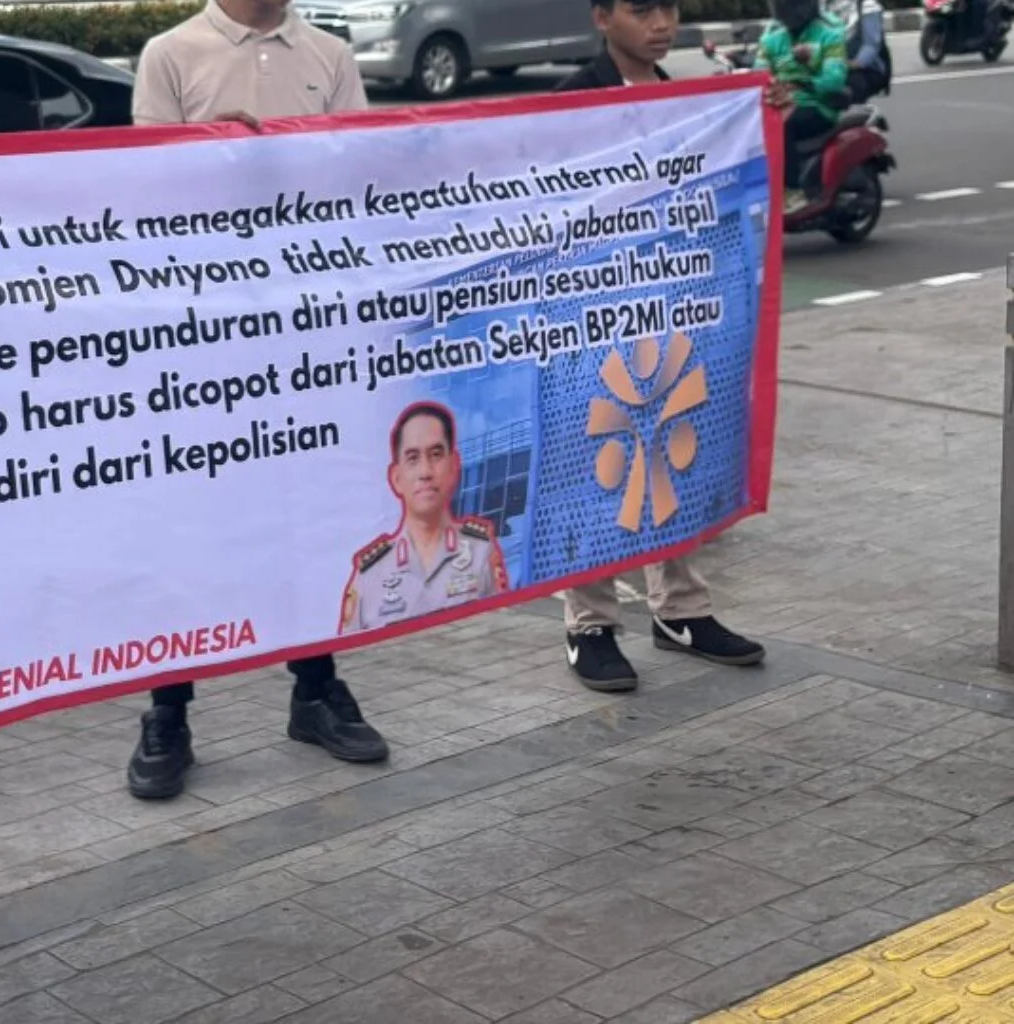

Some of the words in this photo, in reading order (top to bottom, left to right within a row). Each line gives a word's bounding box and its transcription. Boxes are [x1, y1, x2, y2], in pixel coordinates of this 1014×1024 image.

[18, 207, 126, 247] untuk
[136, 190, 355, 239] menegakkan
[364, 166, 531, 220] kepatuhan
[534, 152, 649, 194] internal
[656, 153, 706, 186] agar
[110, 255, 271, 295] Dwiyono
[281, 236, 373, 274] tidak
[384, 213, 555, 263] menduduki
[561, 204, 658, 251] jabatan
[667, 190, 716, 233] sipil
[30, 307, 283, 378] pengunduran
[292, 291, 348, 332] diri
[356, 290, 428, 322] atau
[436, 268, 539, 323] pensiun
[544, 253, 624, 296] sesuai
[629, 245, 712, 284] hukum
[21, 390, 135, 432] harus
[147, 363, 281, 413] dicopot
[290, 347, 358, 392] dari
[367, 339, 482, 392] jabatan
[489, 318, 579, 365] Sekjen
[586, 299, 664, 343] BP2MI
[671, 297, 721, 328] atau
[72, 439, 152, 490] dari
[162, 416, 339, 479] kepolisian
[90, 618, 258, 678] INDONESIA
